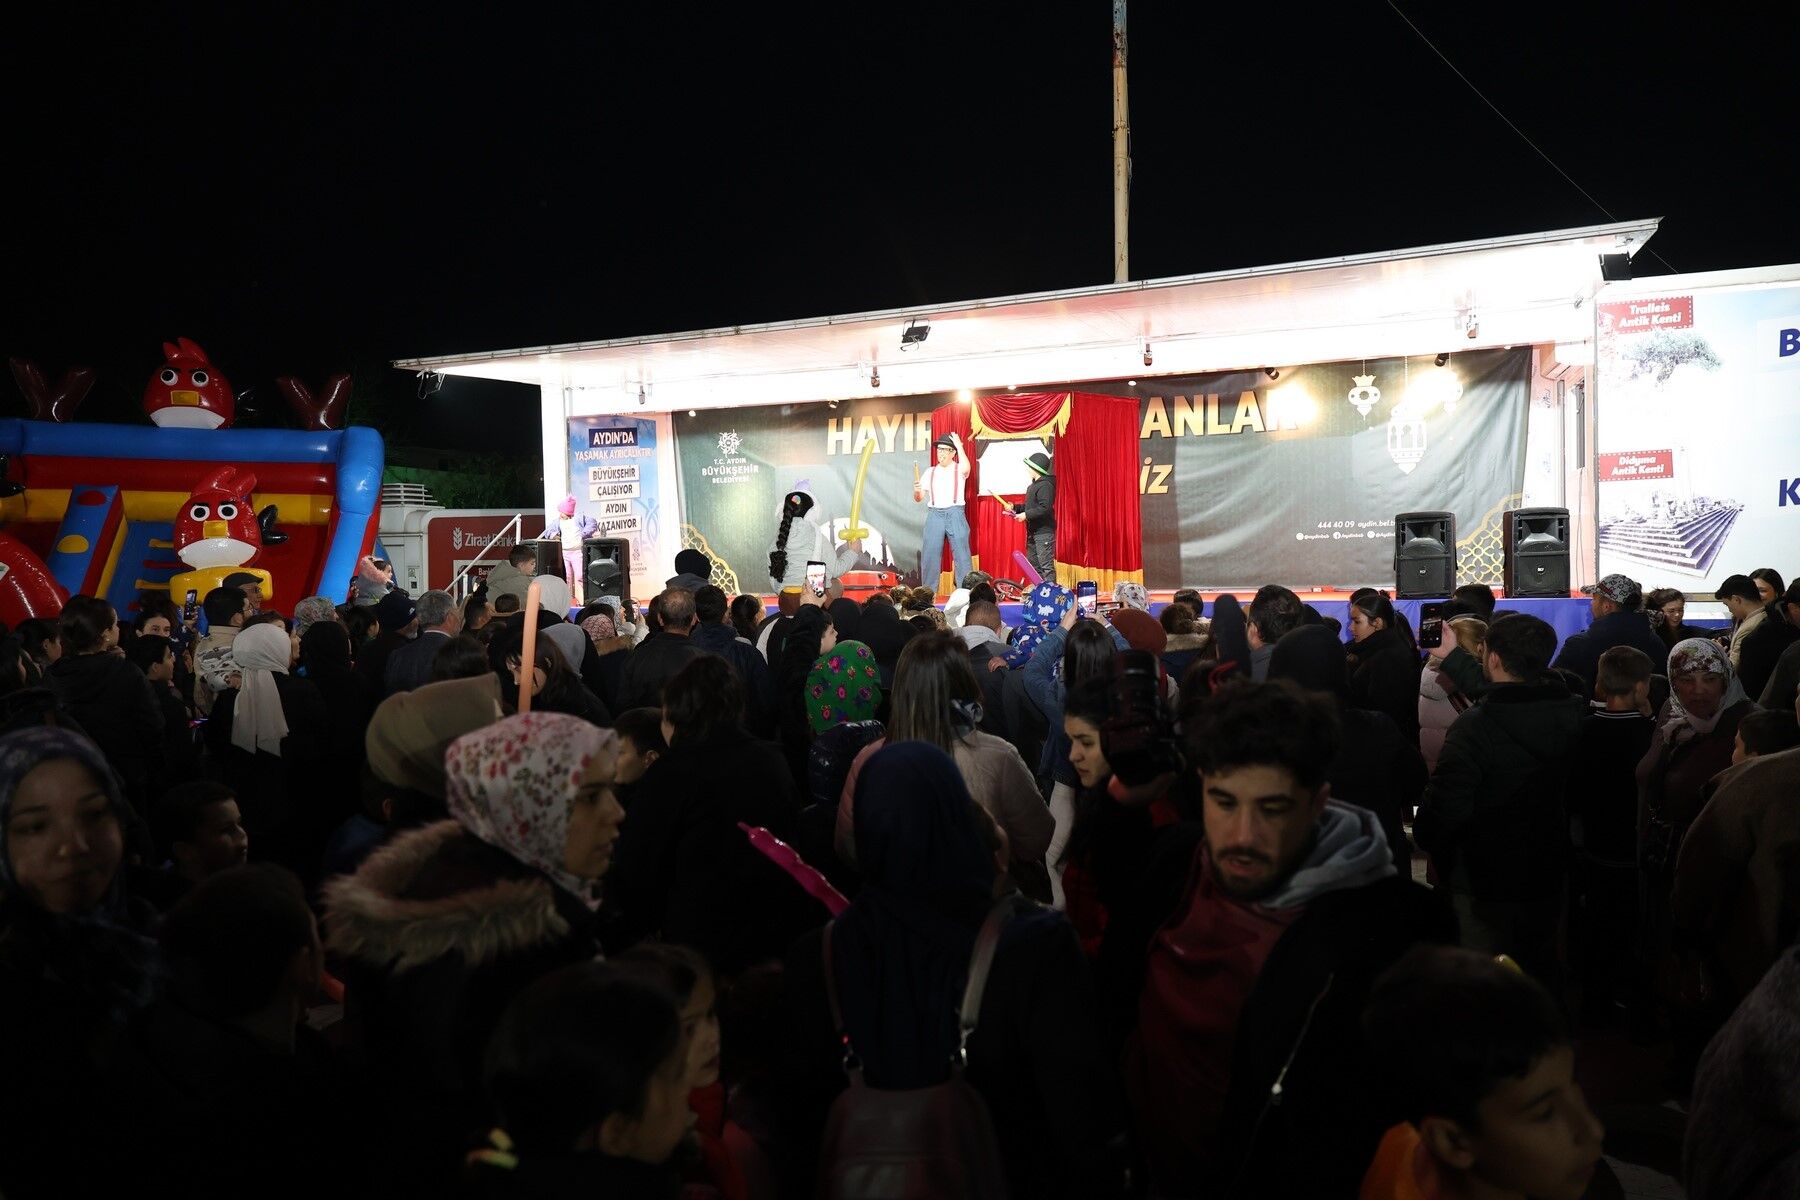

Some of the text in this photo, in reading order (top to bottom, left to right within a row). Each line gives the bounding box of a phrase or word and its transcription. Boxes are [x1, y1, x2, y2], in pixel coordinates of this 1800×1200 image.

[1619, 312, 1682, 327] Antik Kenti
[1779, 328, 1800, 358] B
[593, 431, 635, 445] AYDIN'DA
[574, 449, 609, 462] YAŞAMAK
[1619, 456, 1656, 466] Didyma
[592, 465, 636, 481] BÜYÜKŞEHİR
[702, 464, 759, 476] BÜYÜKŞEHİR
[1611, 463, 1665, 476] Antik Kenti
[597, 484, 633, 498] ÇALIŞIYOR
[1778, 477, 1800, 507] K
[605, 503, 627, 514] AYDIN
[464, 532, 490, 547] Ziraat
